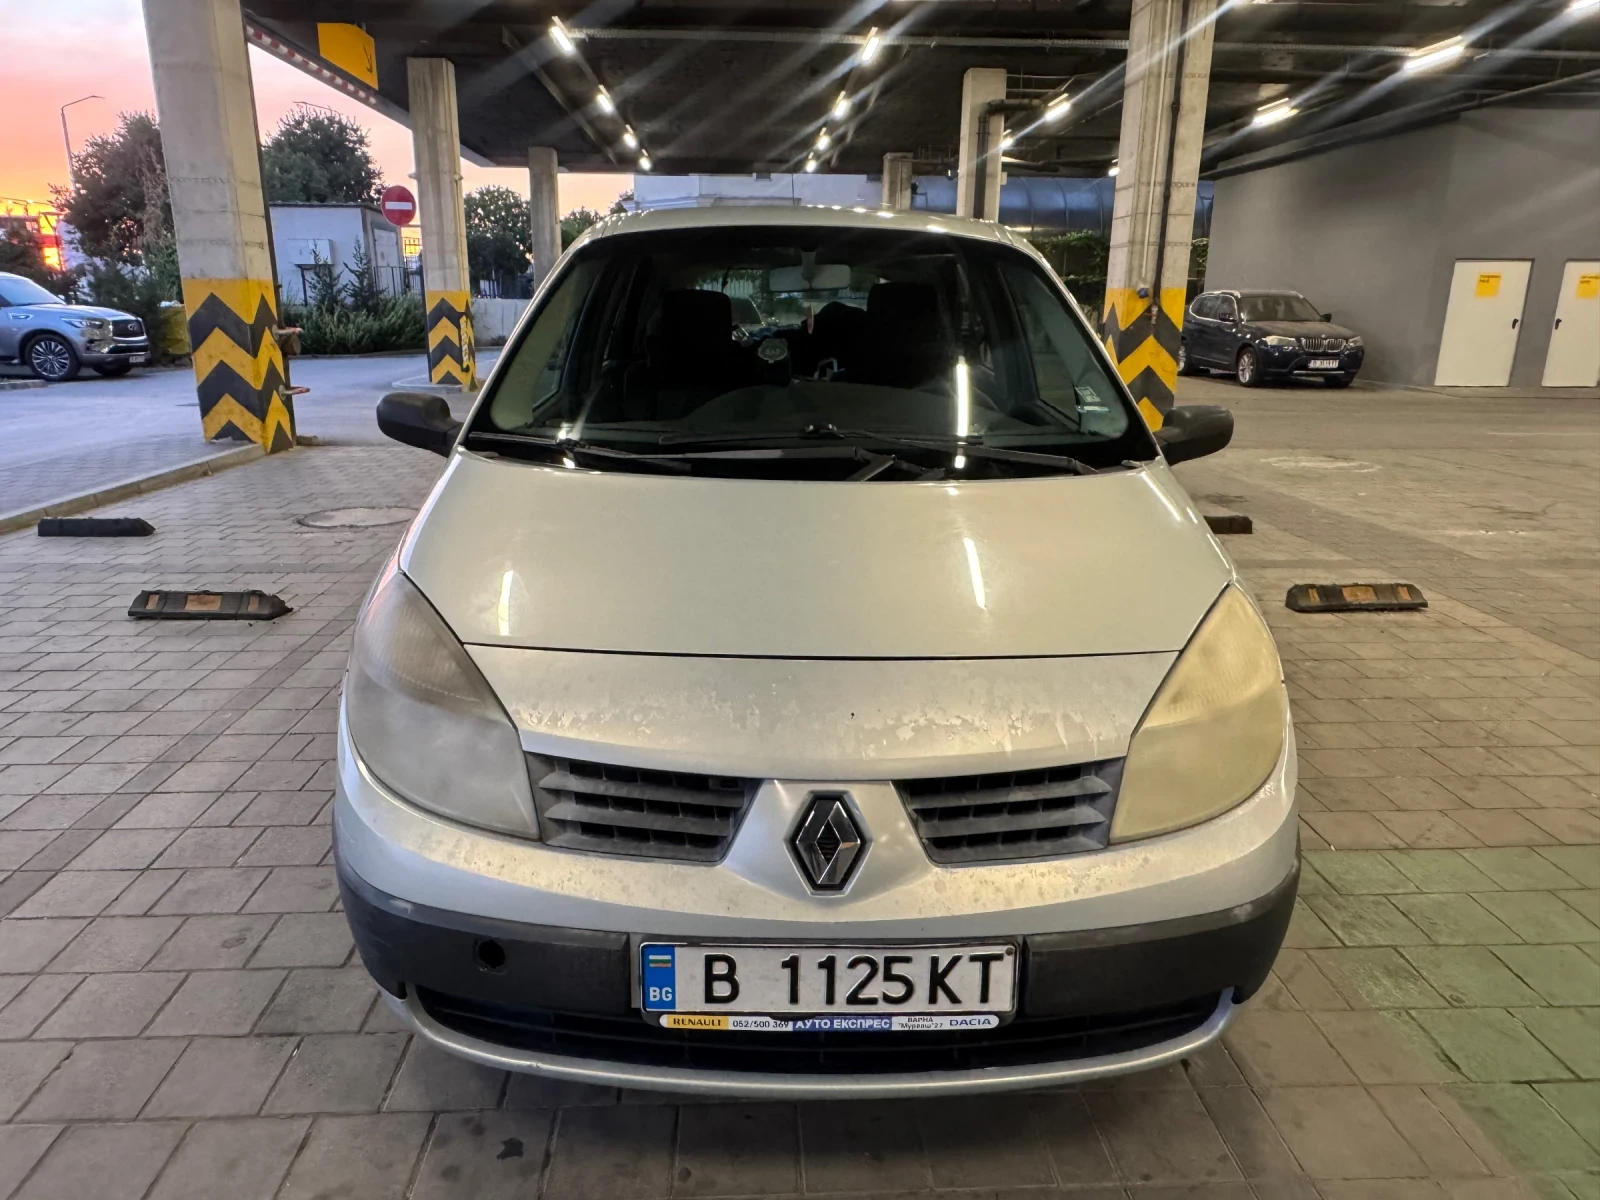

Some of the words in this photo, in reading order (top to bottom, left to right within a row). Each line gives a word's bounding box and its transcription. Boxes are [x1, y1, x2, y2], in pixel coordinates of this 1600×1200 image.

[704, 953, 740, 1004] B
[649, 987, 673, 1002] BG
[672, 1017, 722, 1027] RENAULT
[732, 1020, 770, 1029] 052/500
[795, 1018, 830, 1030] АУТО
[833, 1018, 890, 1029] ЕКСПРЕС
[949, 1018, 992, 1027] DACIA
